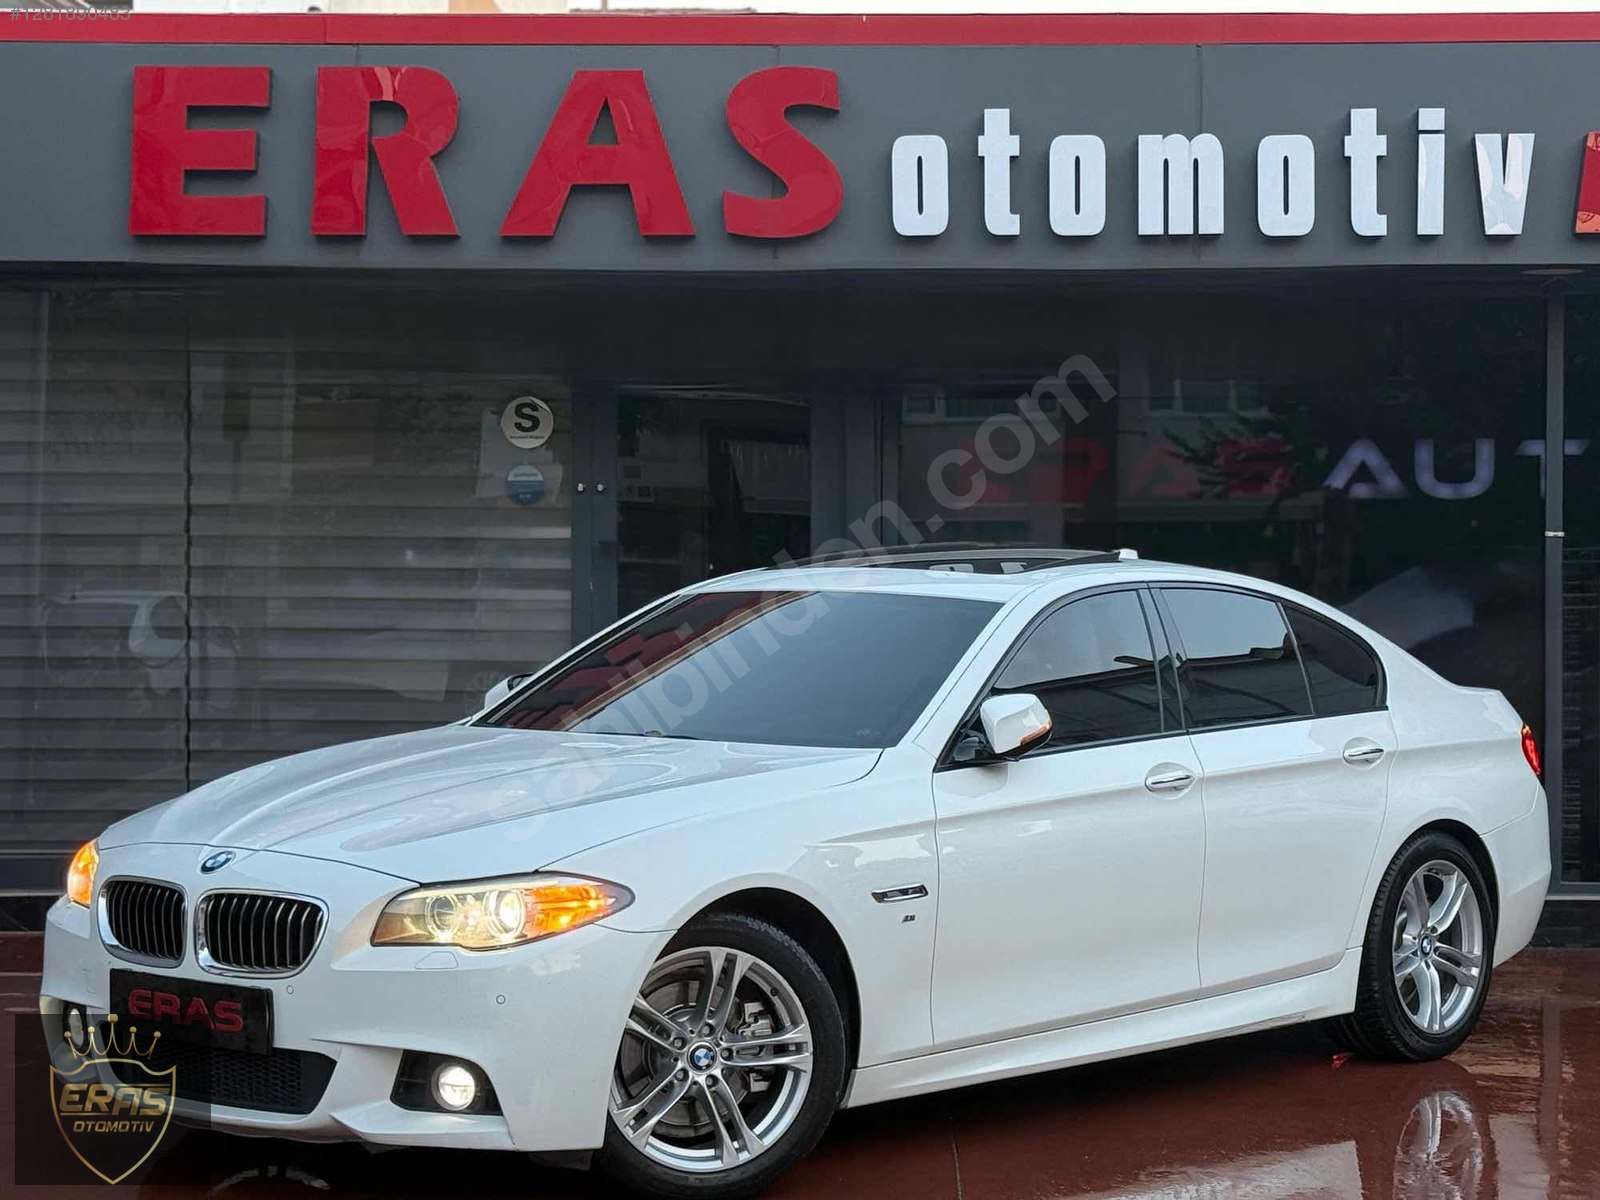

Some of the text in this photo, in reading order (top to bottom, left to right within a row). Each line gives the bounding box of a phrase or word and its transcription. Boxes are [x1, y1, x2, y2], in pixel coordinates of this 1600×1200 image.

[129, 66, 1535, 238] ERAS otomotiv
[514, 402, 540, 432] S
[128, 988, 244, 1033] ERAS
